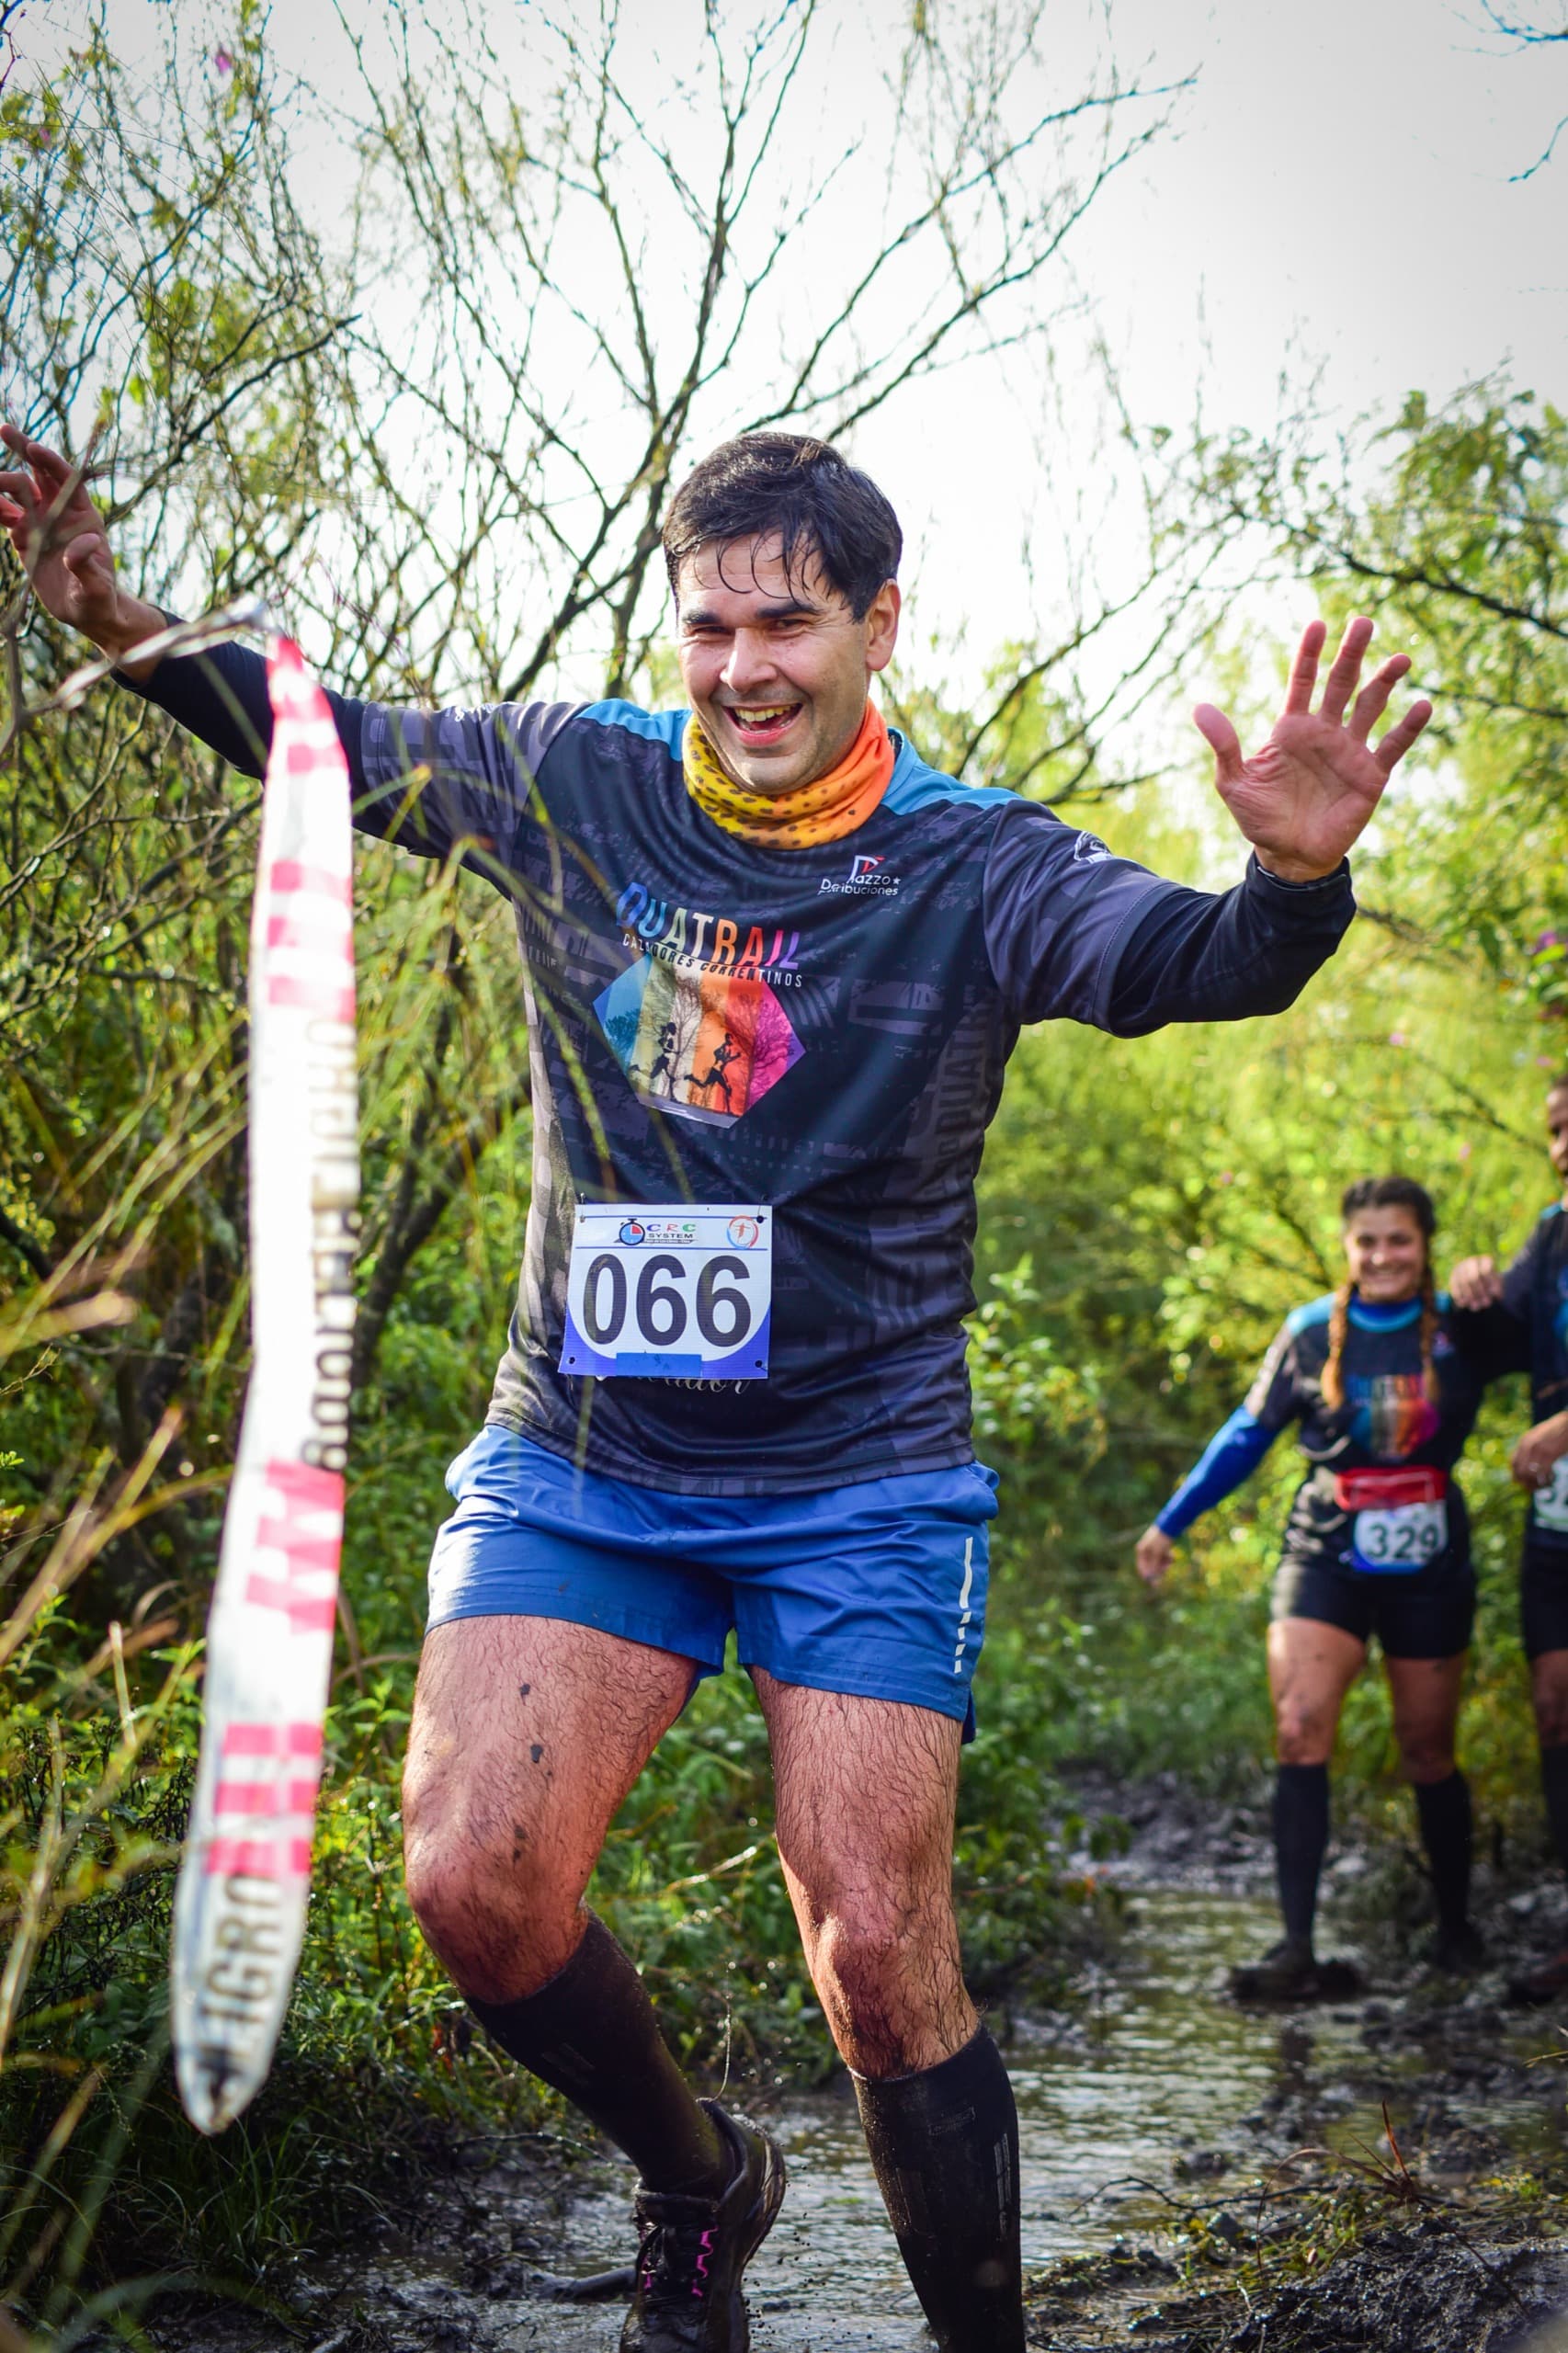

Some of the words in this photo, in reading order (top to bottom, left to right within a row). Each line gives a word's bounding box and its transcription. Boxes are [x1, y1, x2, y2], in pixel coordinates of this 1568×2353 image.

[615, 881, 801, 971] QUATRAIL
[622, 933, 695, 968] CAZADORES
[699, 961, 802, 988] CORRENTINOS
[646, 1223, 697, 1233] CRC
[583, 1253, 752, 1347] 066
[1367, 1523, 1440, 1560] 329
